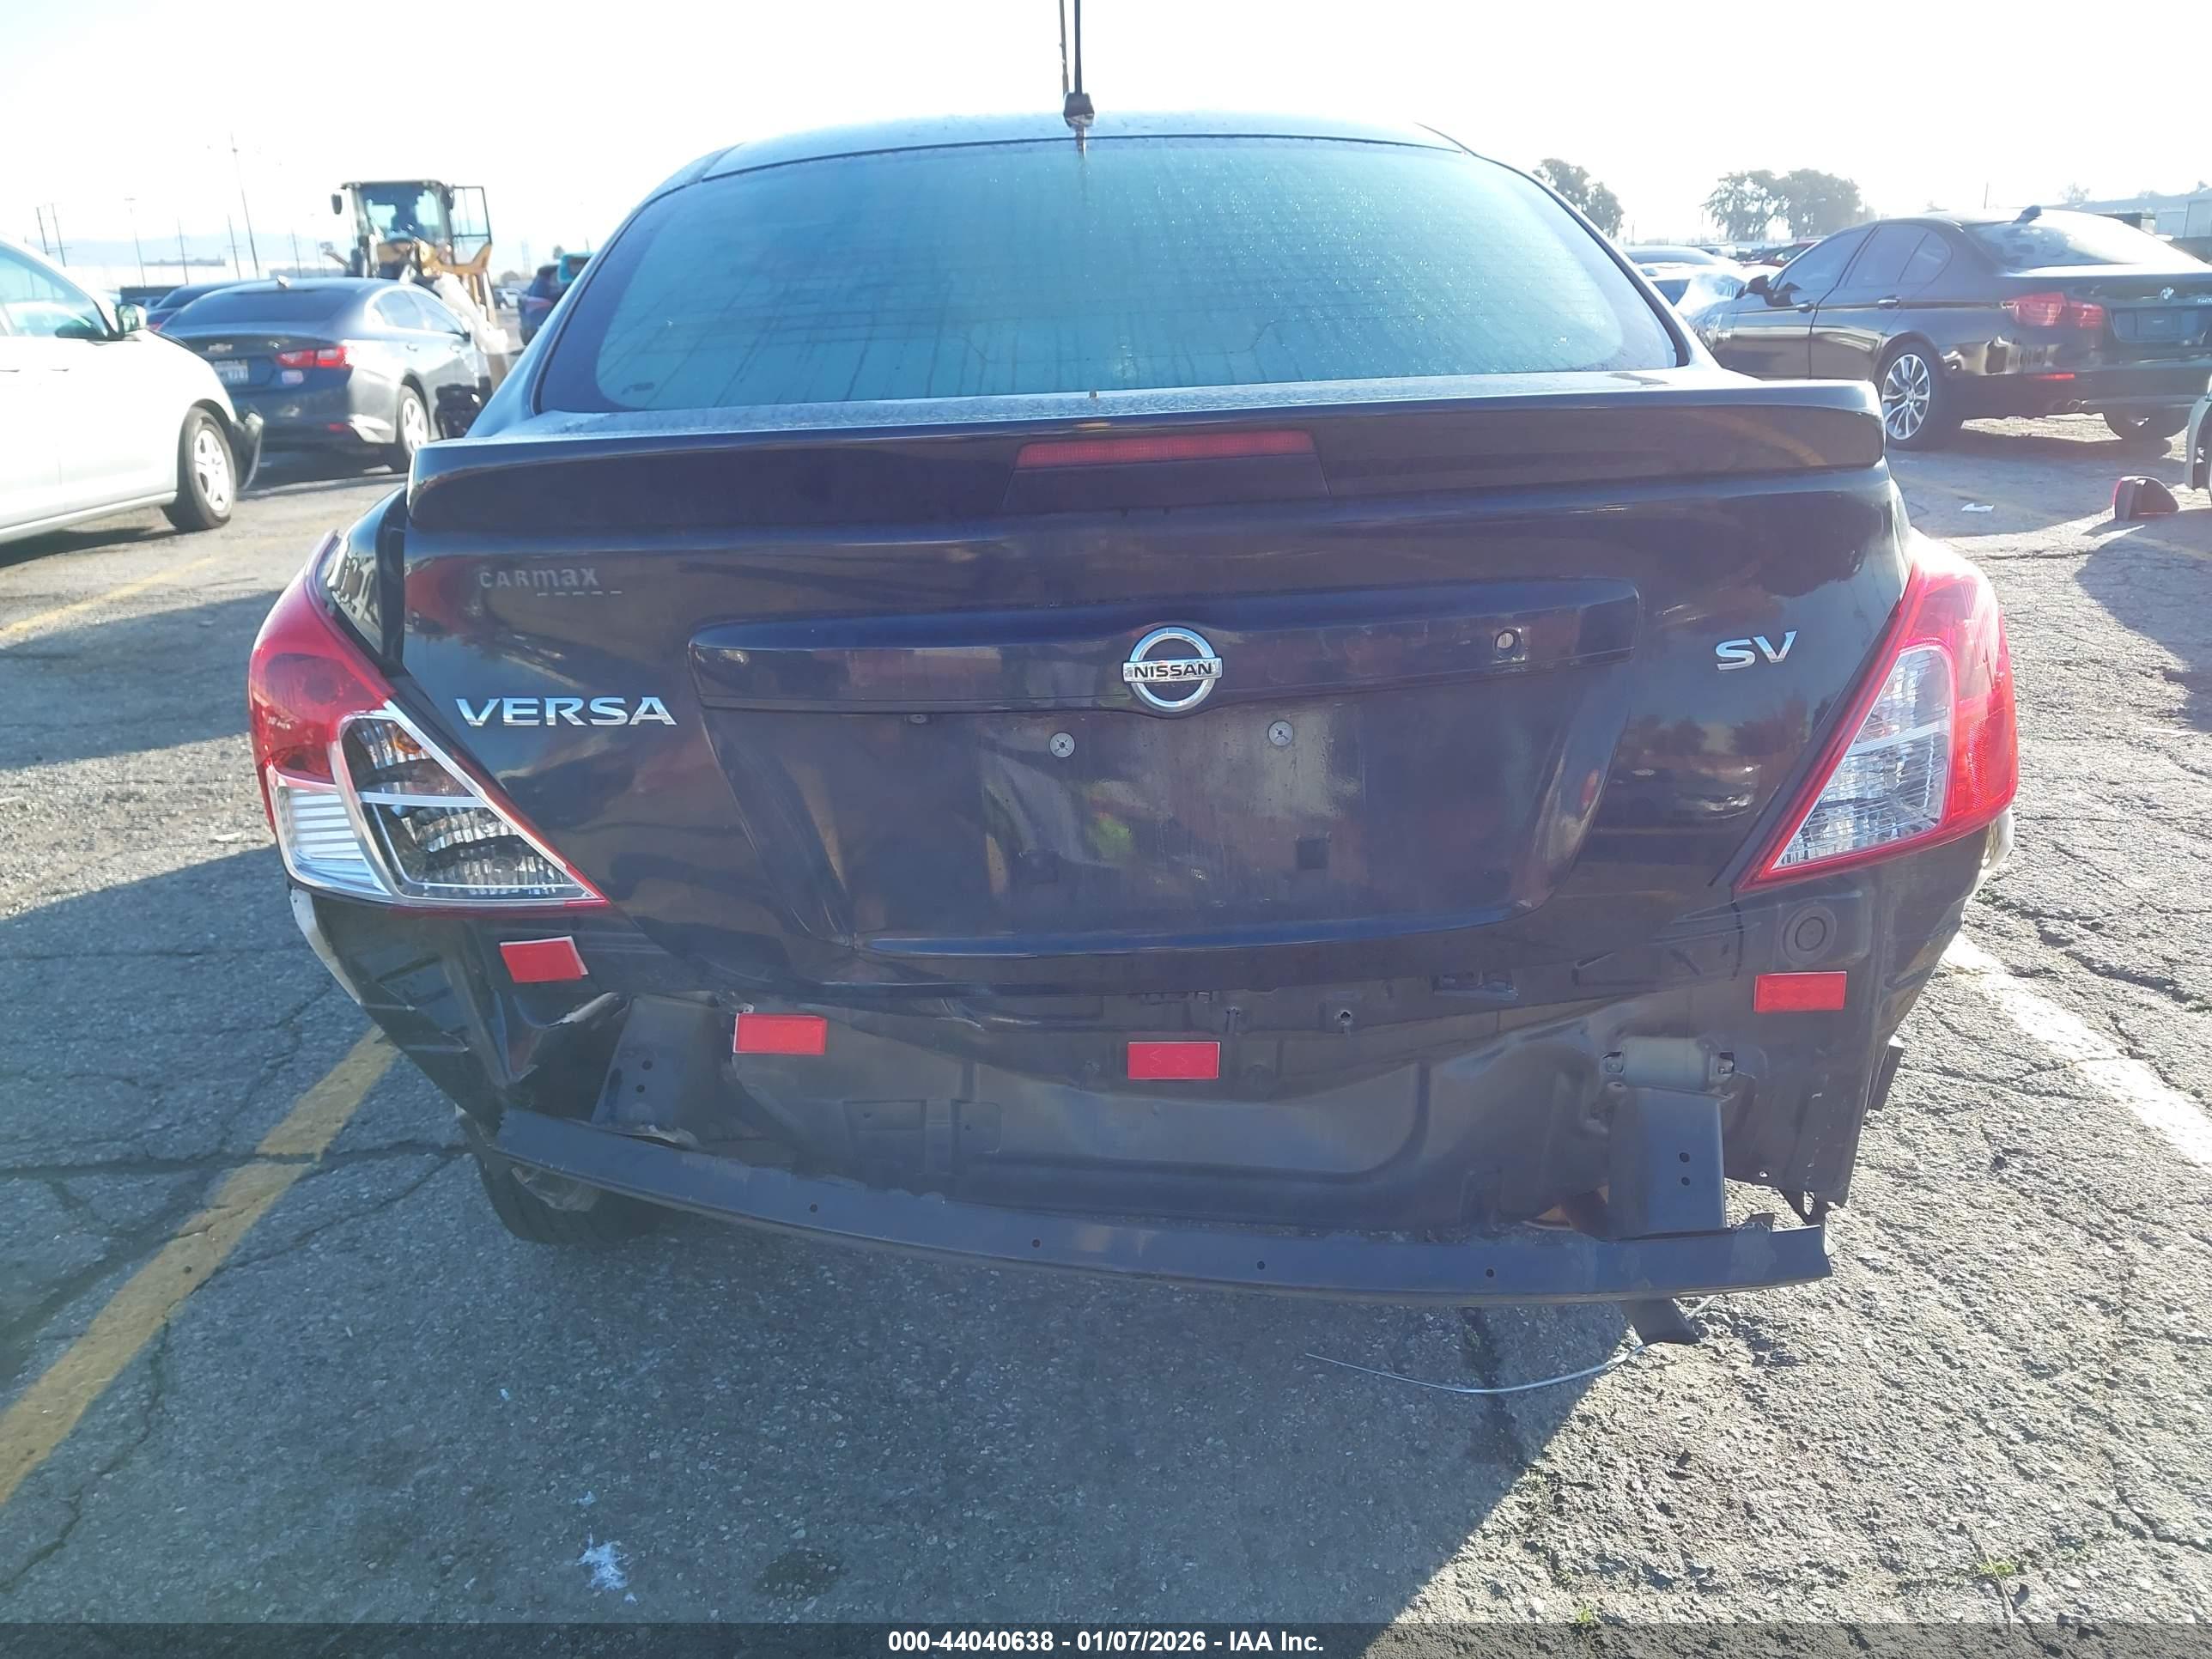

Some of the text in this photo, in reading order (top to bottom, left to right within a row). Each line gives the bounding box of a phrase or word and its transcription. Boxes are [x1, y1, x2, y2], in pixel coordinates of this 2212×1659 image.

[1715, 630, 1797, 670] SV
[1133, 662, 1212, 678] NISSAN
[454, 696, 678, 726] VERSA
